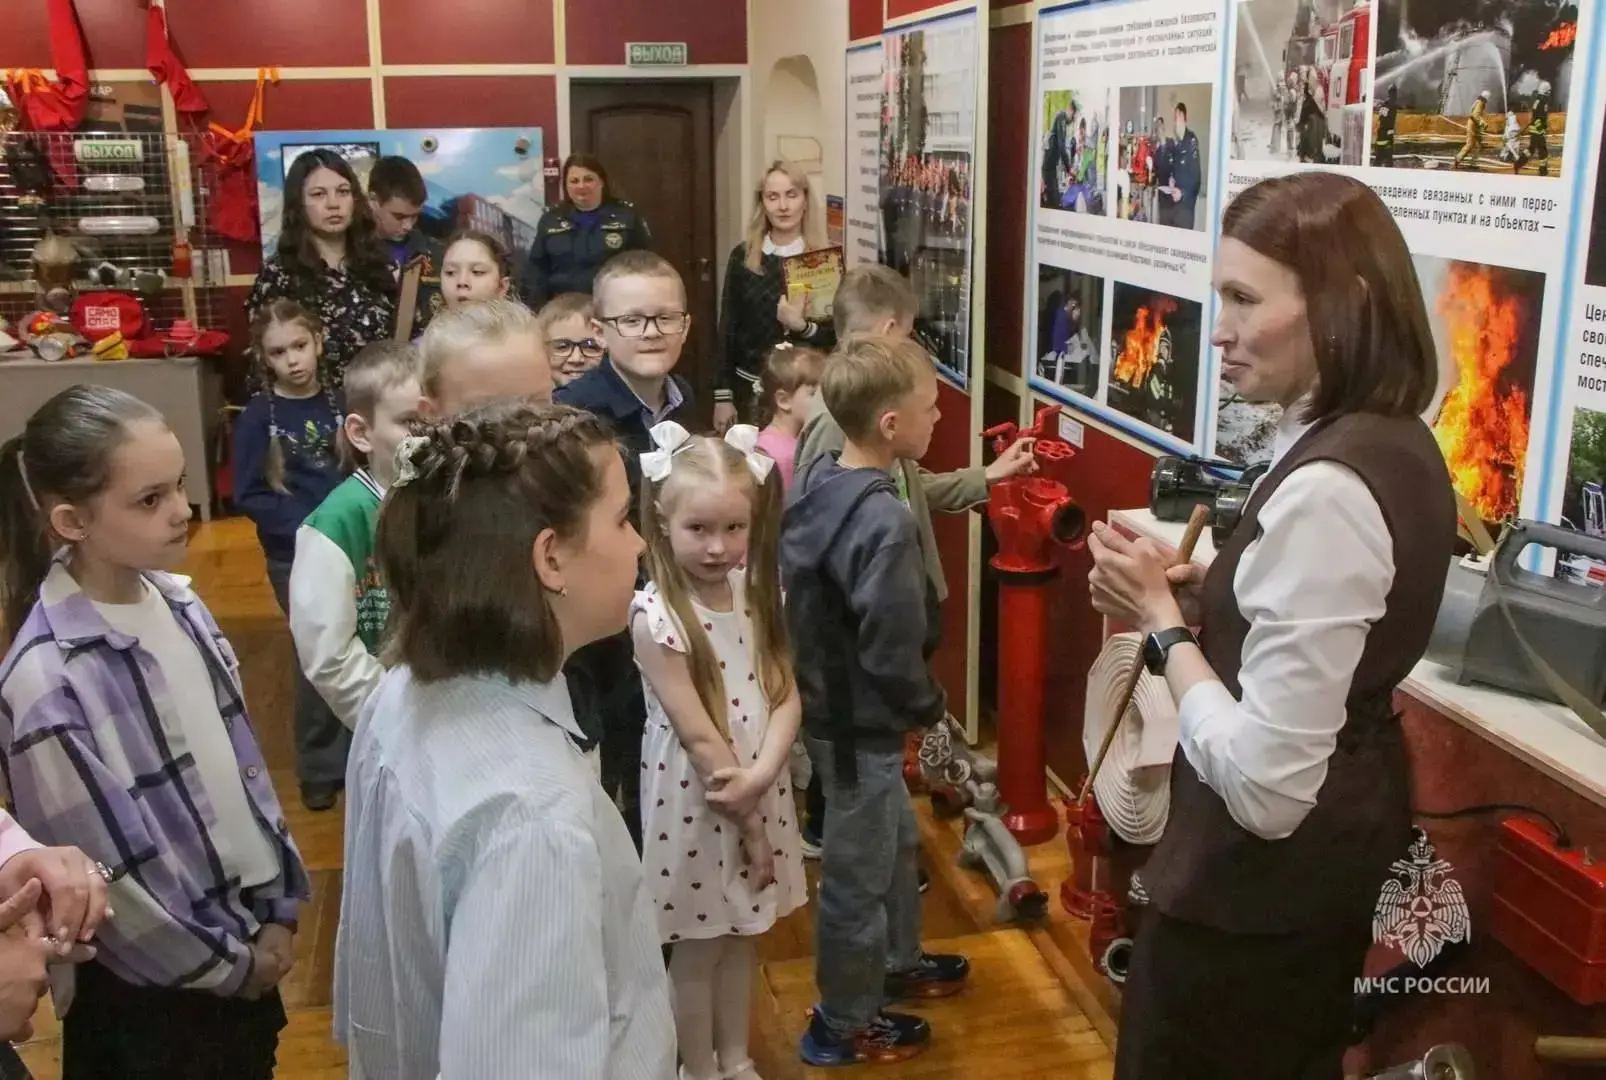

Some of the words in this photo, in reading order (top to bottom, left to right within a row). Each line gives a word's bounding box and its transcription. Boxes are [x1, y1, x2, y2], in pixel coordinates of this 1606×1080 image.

[632, 46, 682, 63] ВЫХОД
[83, 145, 134, 158] ВЫХОД
[1368, 186, 1417, 200] роведение
[1423, 188, 1473, 204] связанных
[1479, 193, 1485, 205] с
[1490, 194, 1517, 208] ними
[1522, 197, 1557, 214] перво-
[1432, 210, 1468, 225] пунктах
[1471, 214, 1477, 225] и
[1480, 214, 1492, 227] на
[1495, 212, 1540, 232] объектах
[1583, 329, 1606, 345] сво
